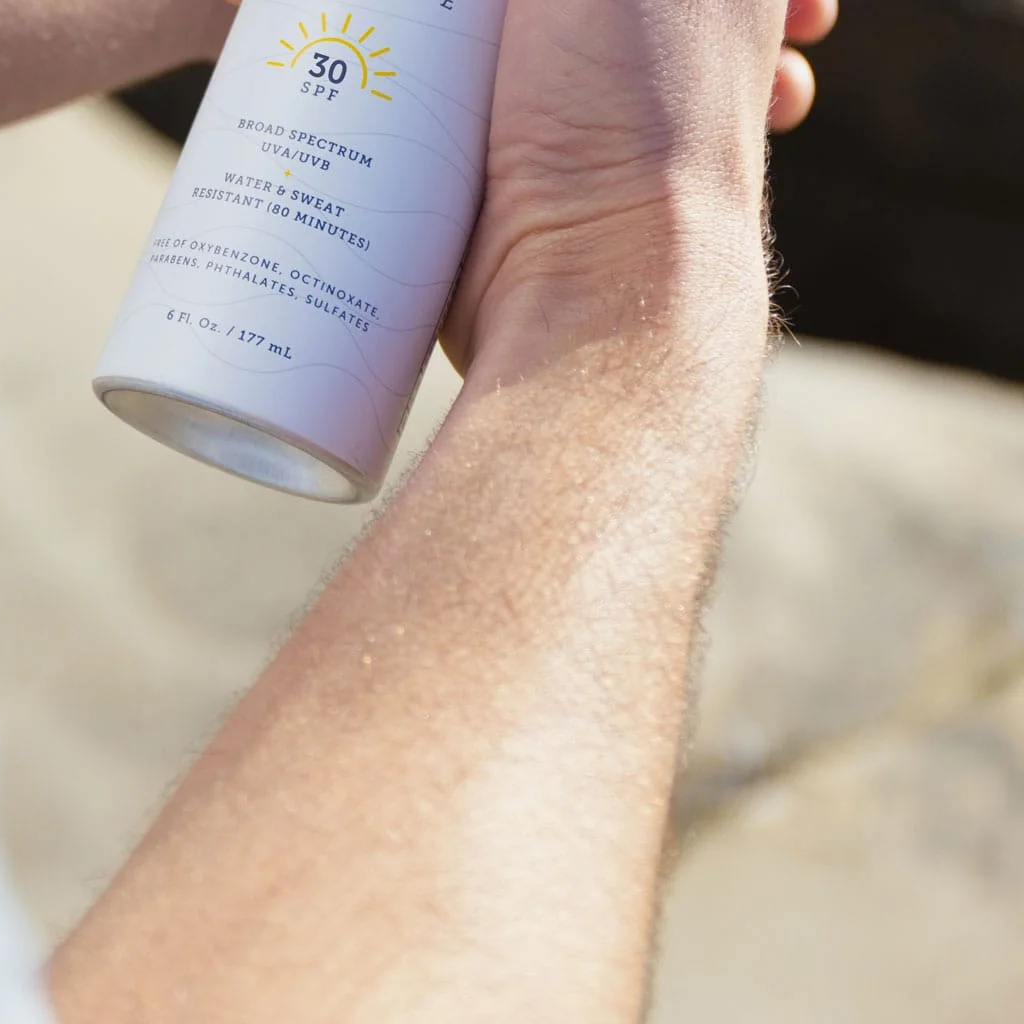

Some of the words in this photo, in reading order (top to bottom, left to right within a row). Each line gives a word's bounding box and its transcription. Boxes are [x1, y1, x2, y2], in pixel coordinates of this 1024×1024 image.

[300, 81, 339, 102] SPF
[308, 52, 348, 85] 30
[237, 118, 285, 137] BROAD
[288, 130, 374, 168] SPECTRUM
[261, 142, 331, 171] UVA/UVB
[192, 187, 264, 210] RESISTANT
[266, 202, 290, 218] (80
[294, 211, 371, 252] MINUTES)
[224, 172, 273, 193] WATER
[276, 185, 286, 196] &
[290, 189, 345, 218] SWEAT
[149, 254, 200, 269] PARABENS,
[205, 261, 298, 300] PHTHALATES,
[305, 294, 370, 332] SULFATES
[152, 238, 171, 248] FREE
[173, 238, 187, 248] OF
[189, 240, 282, 276] OXYBENZONE,
[290, 269, 380, 321] OCTINOXATE,
[166, 309, 175, 320] 6
[198, 317, 221, 333] Oz.
[226, 326, 235, 337] /
[237, 329, 265, 347] 177
[268, 342, 293, 360] mL
